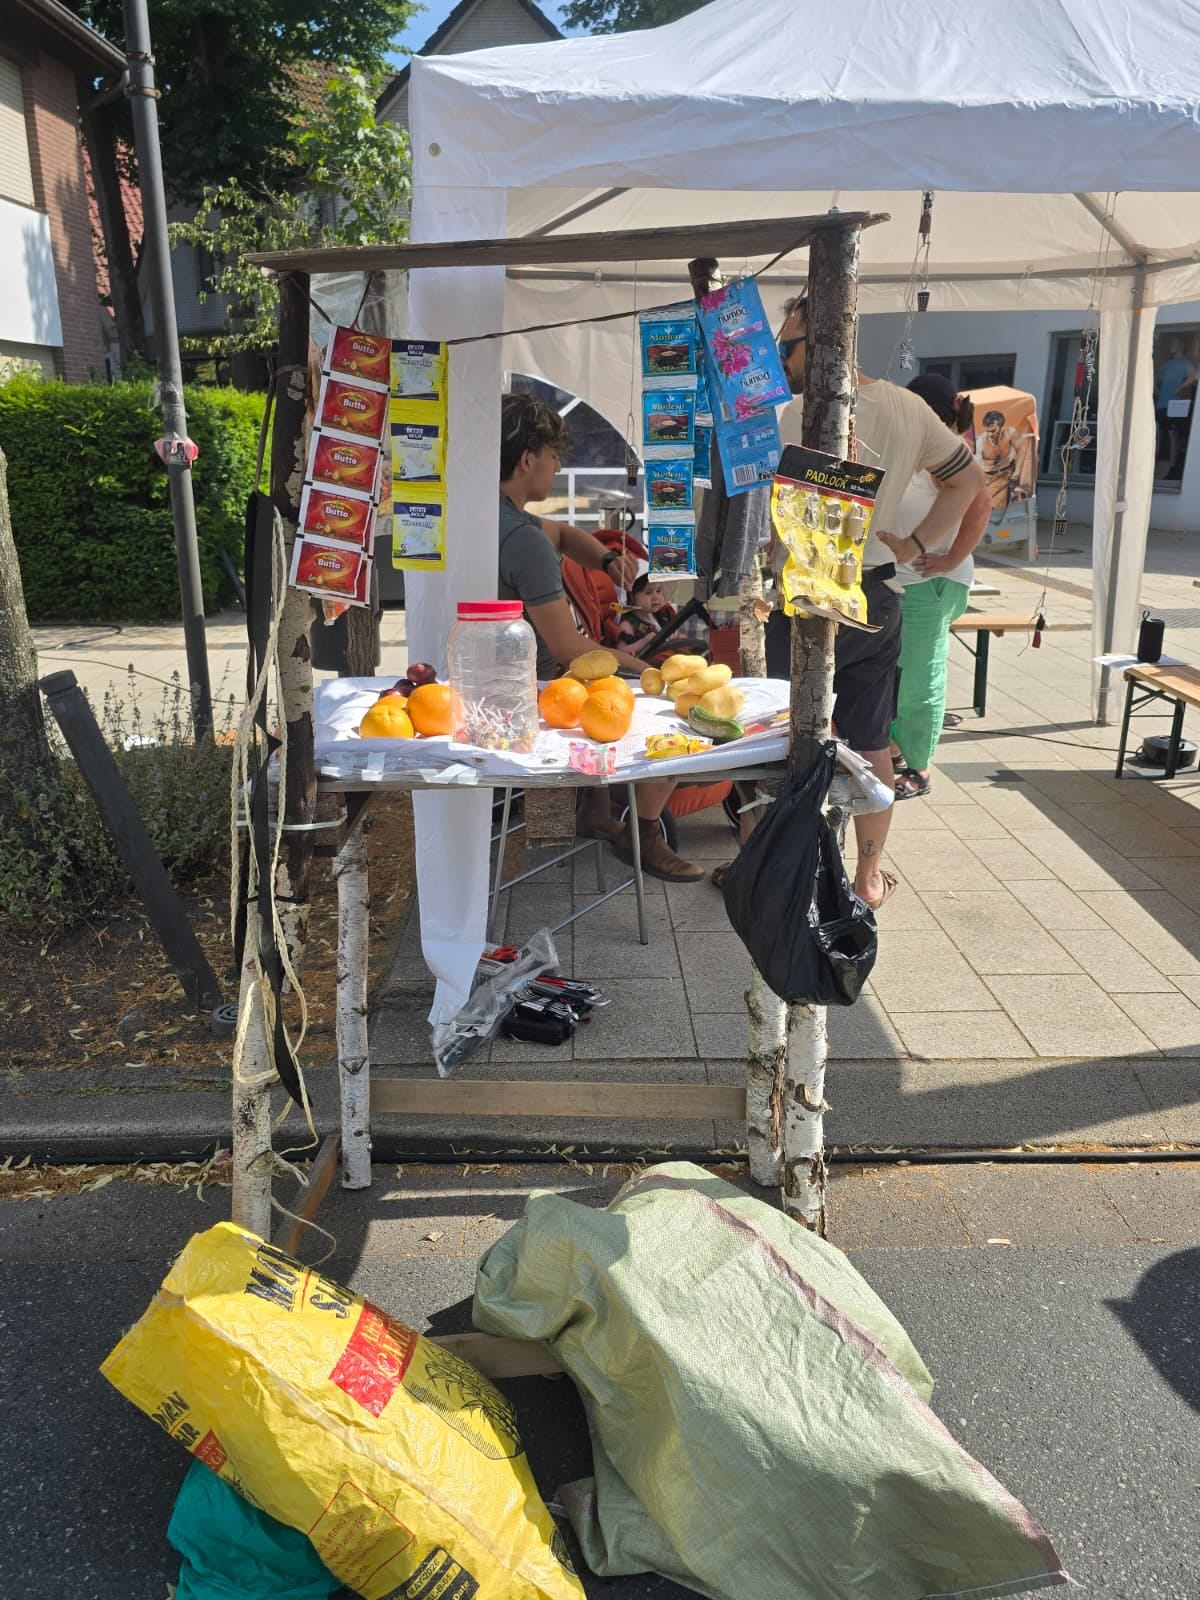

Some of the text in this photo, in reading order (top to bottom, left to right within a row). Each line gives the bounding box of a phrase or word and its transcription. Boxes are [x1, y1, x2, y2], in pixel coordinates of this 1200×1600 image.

[352, 342, 375, 354] Butto
[343, 398, 366, 410] Butto
[334, 453, 357, 465] Butto
[805, 469, 849, 489] PADLOCK
[325, 506, 349, 518] Butto
[318, 559, 341, 569] Butto
